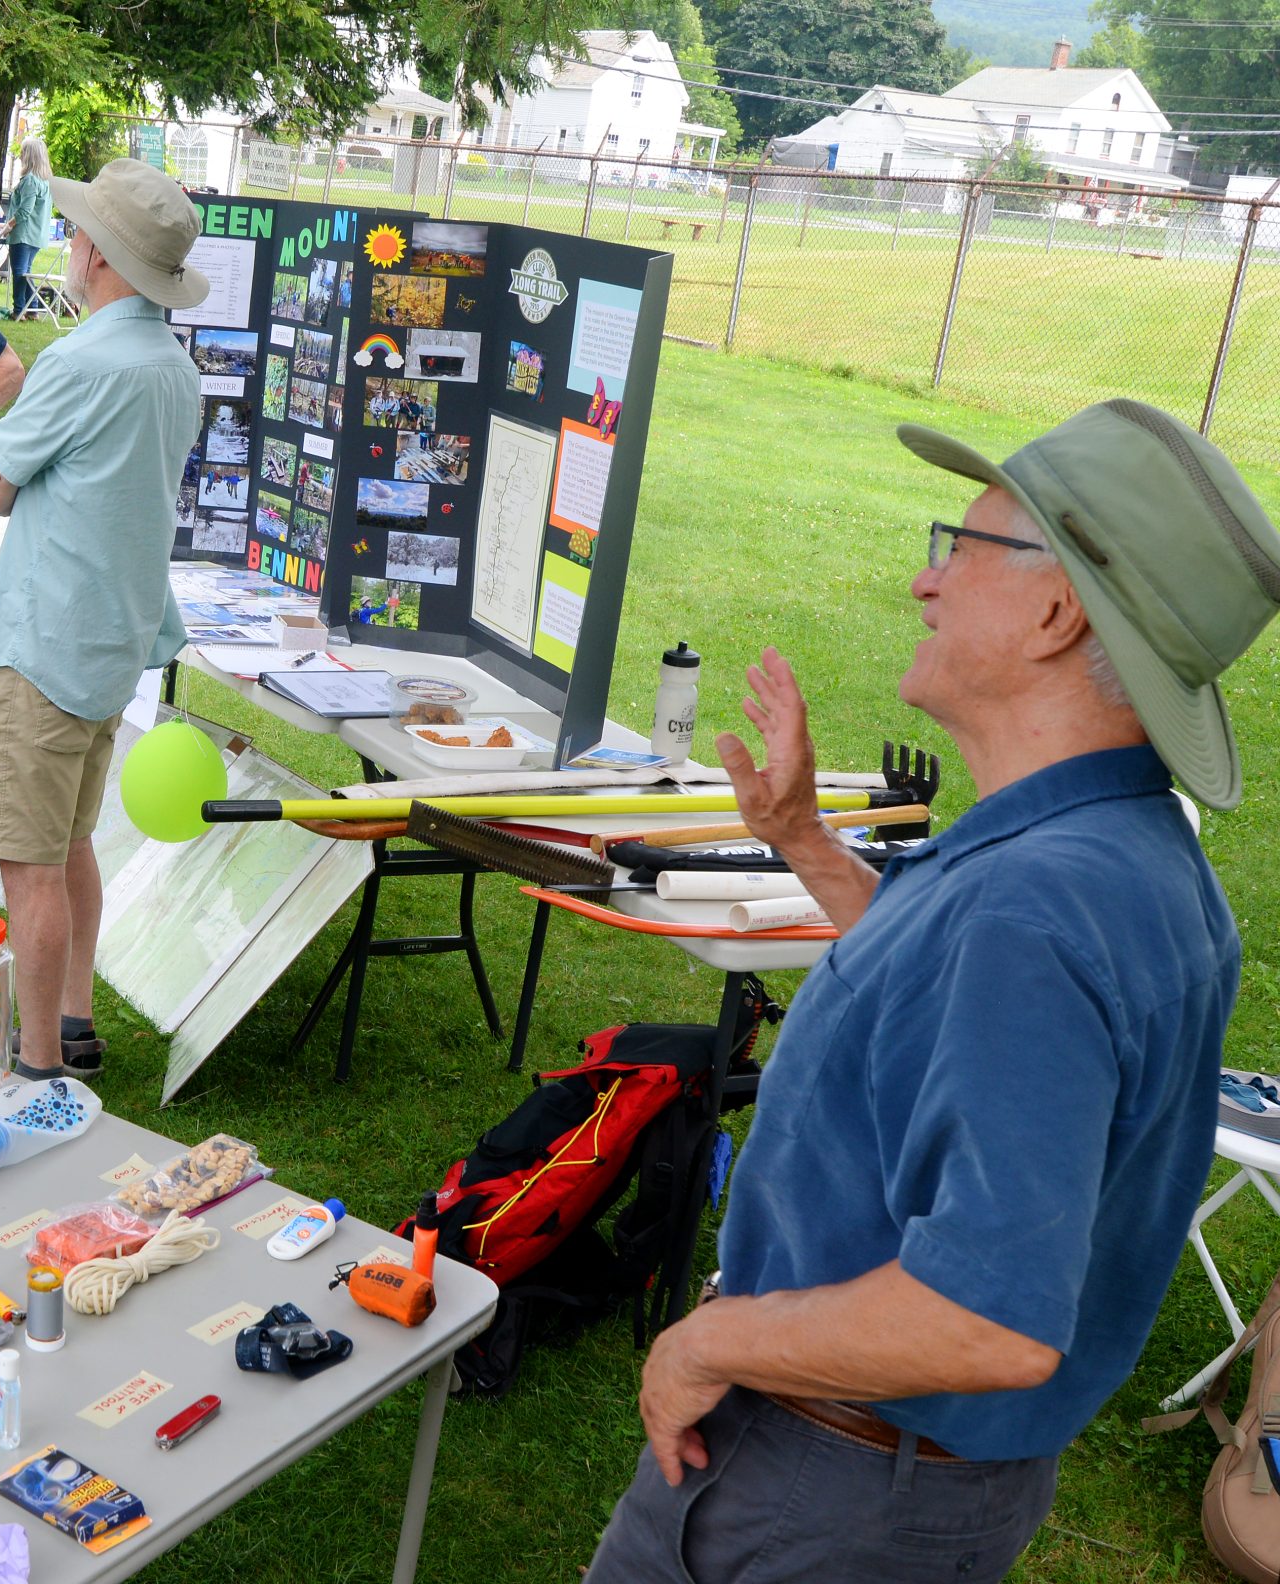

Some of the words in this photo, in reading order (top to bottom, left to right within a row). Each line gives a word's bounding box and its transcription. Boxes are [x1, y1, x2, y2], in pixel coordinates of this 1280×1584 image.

[514, 275, 537, 293] LONG
[537, 281, 561, 300] TRAIL
[206, 382, 237, 391] WINTER
[363, 1268, 404, 1288] Ben's
[208, 1311, 251, 1335] LIGHT
[93, 1377, 147, 1411] MULTITOOL
[129, 1382, 164, 1405] KNIFE
[70, 1478, 99, 1499] Pads
[76, 1478, 113, 1507] Blister
